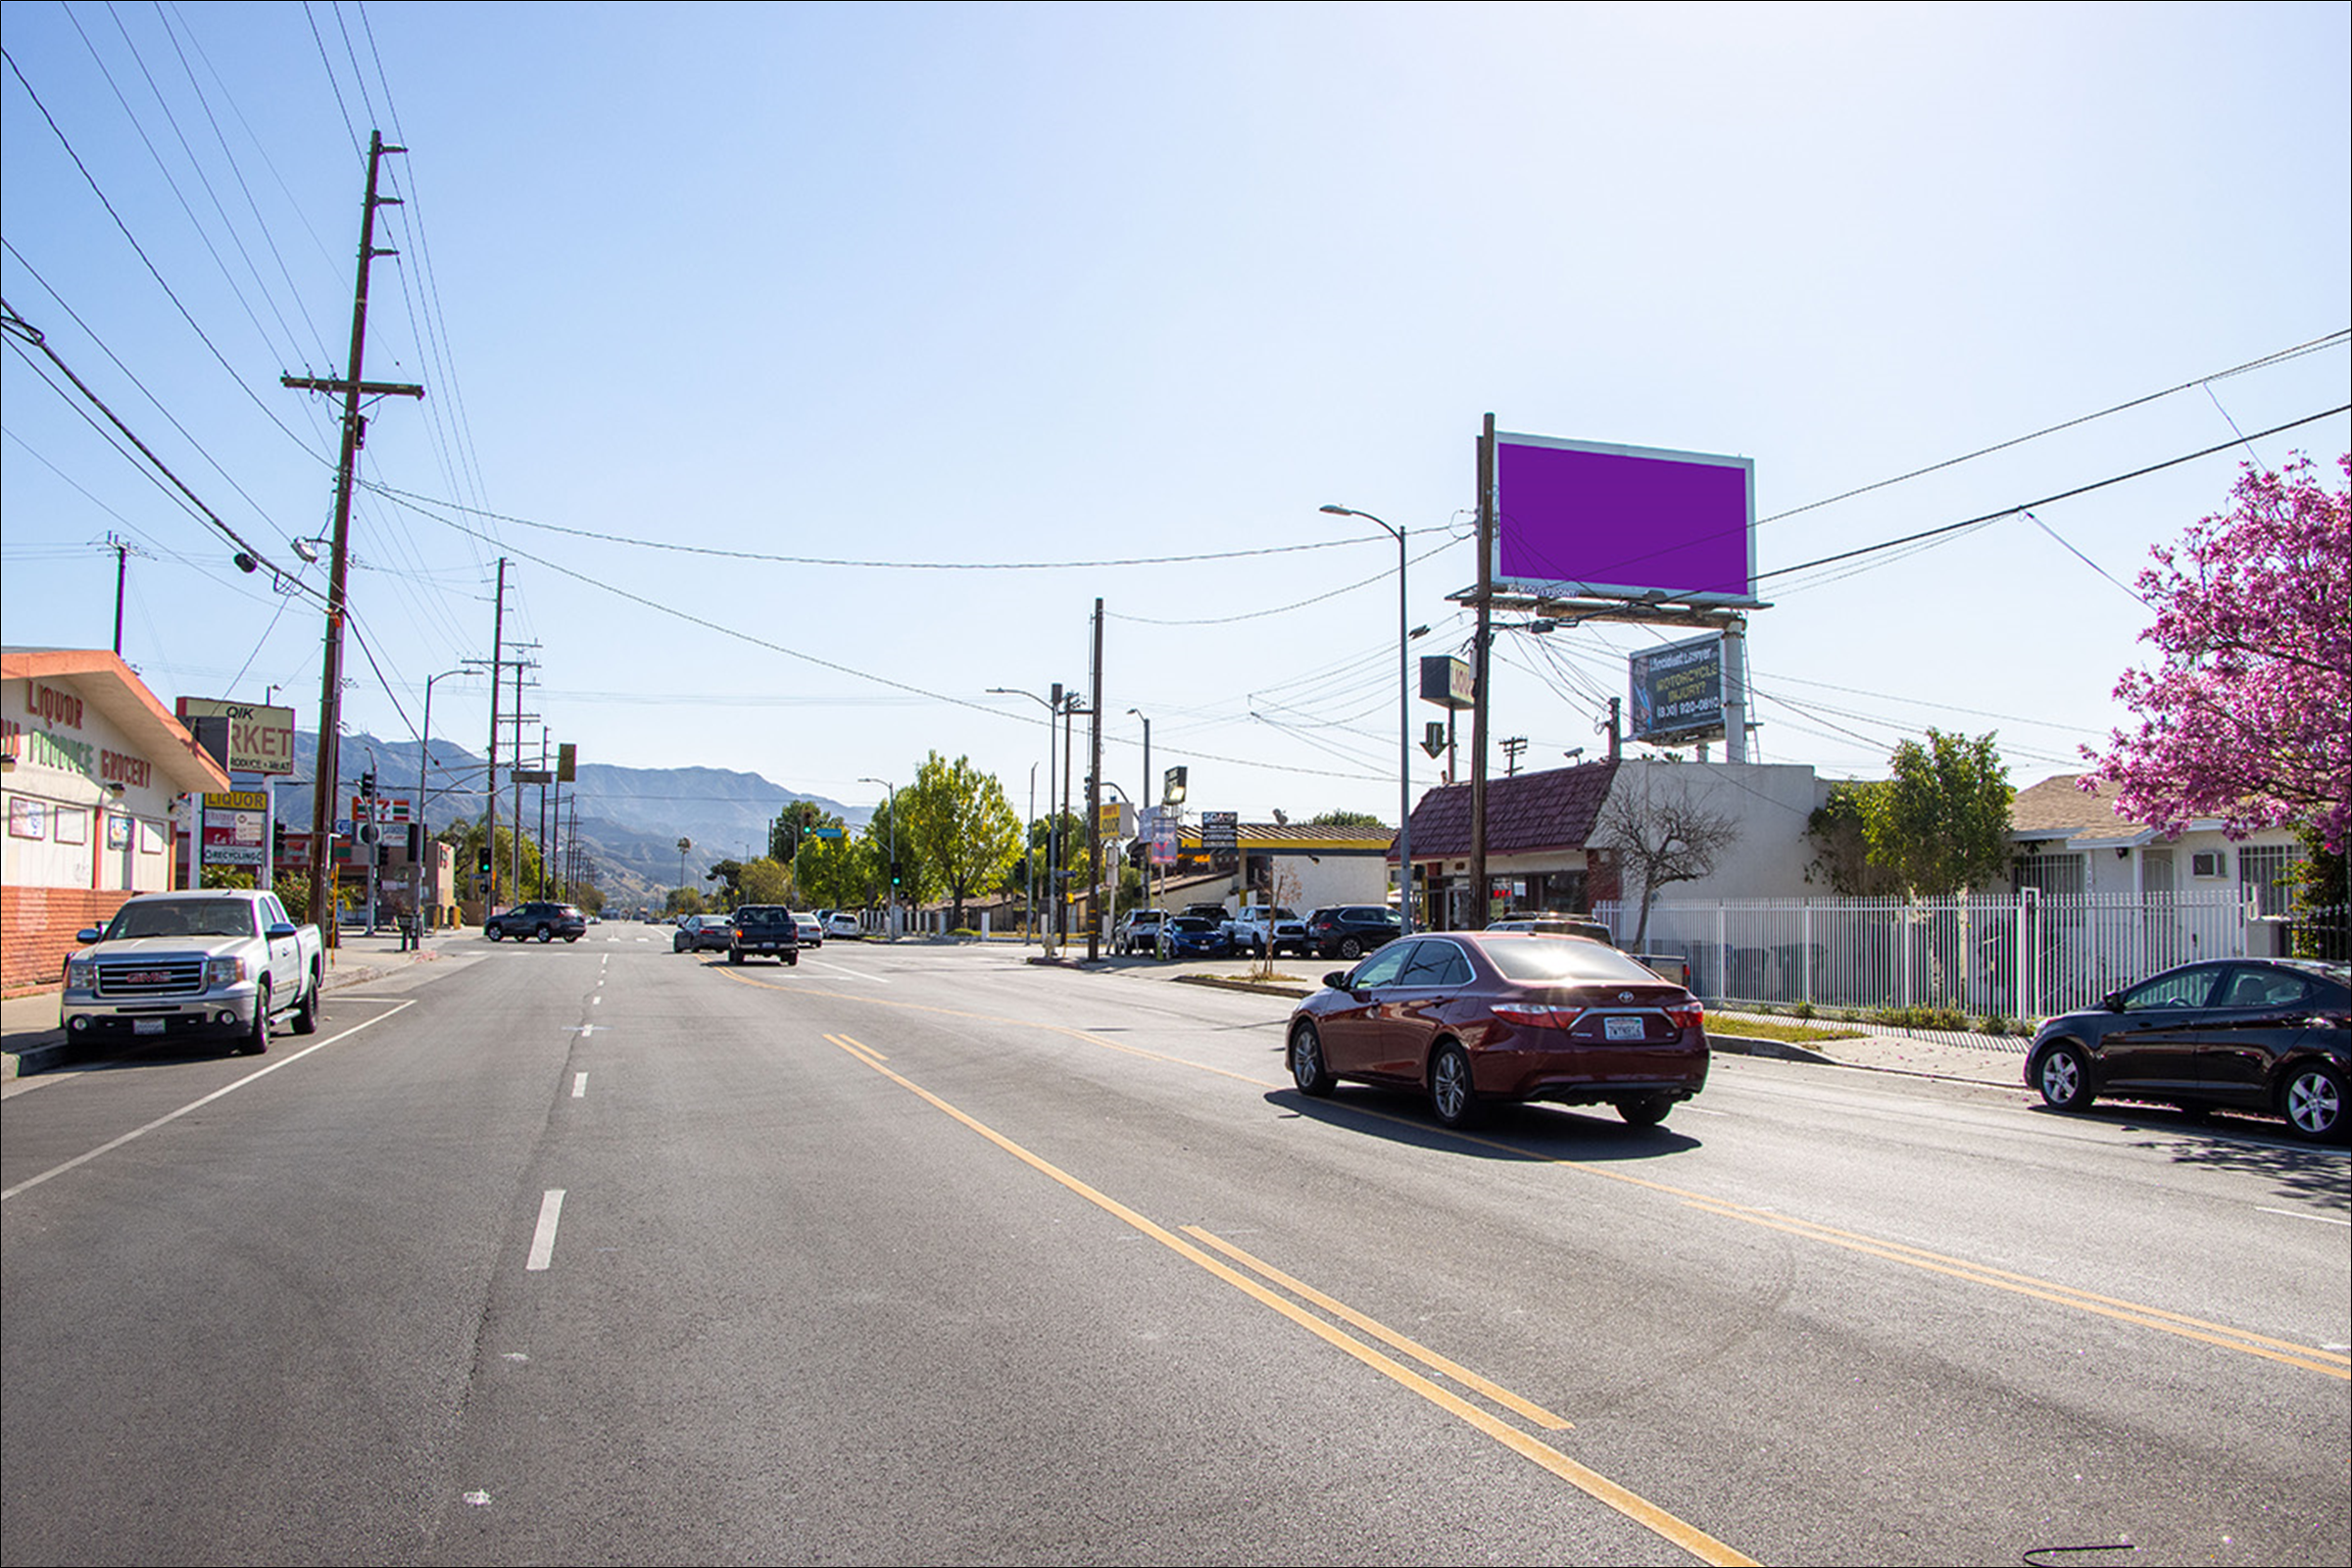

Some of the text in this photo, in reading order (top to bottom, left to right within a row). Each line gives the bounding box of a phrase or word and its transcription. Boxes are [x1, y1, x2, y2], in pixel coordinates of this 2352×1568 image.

[1656, 662, 1718, 693] MOTORCYCLE
[26, 680, 83, 730] LIQUOR
[225, 706, 254, 720] QIK
[29, 728, 94, 775] PRODUCE
[207, 792, 264, 808] LIQUOR
[212, 850, 257, 861] RECYCLING
[126, 971, 172, 983] GMC
